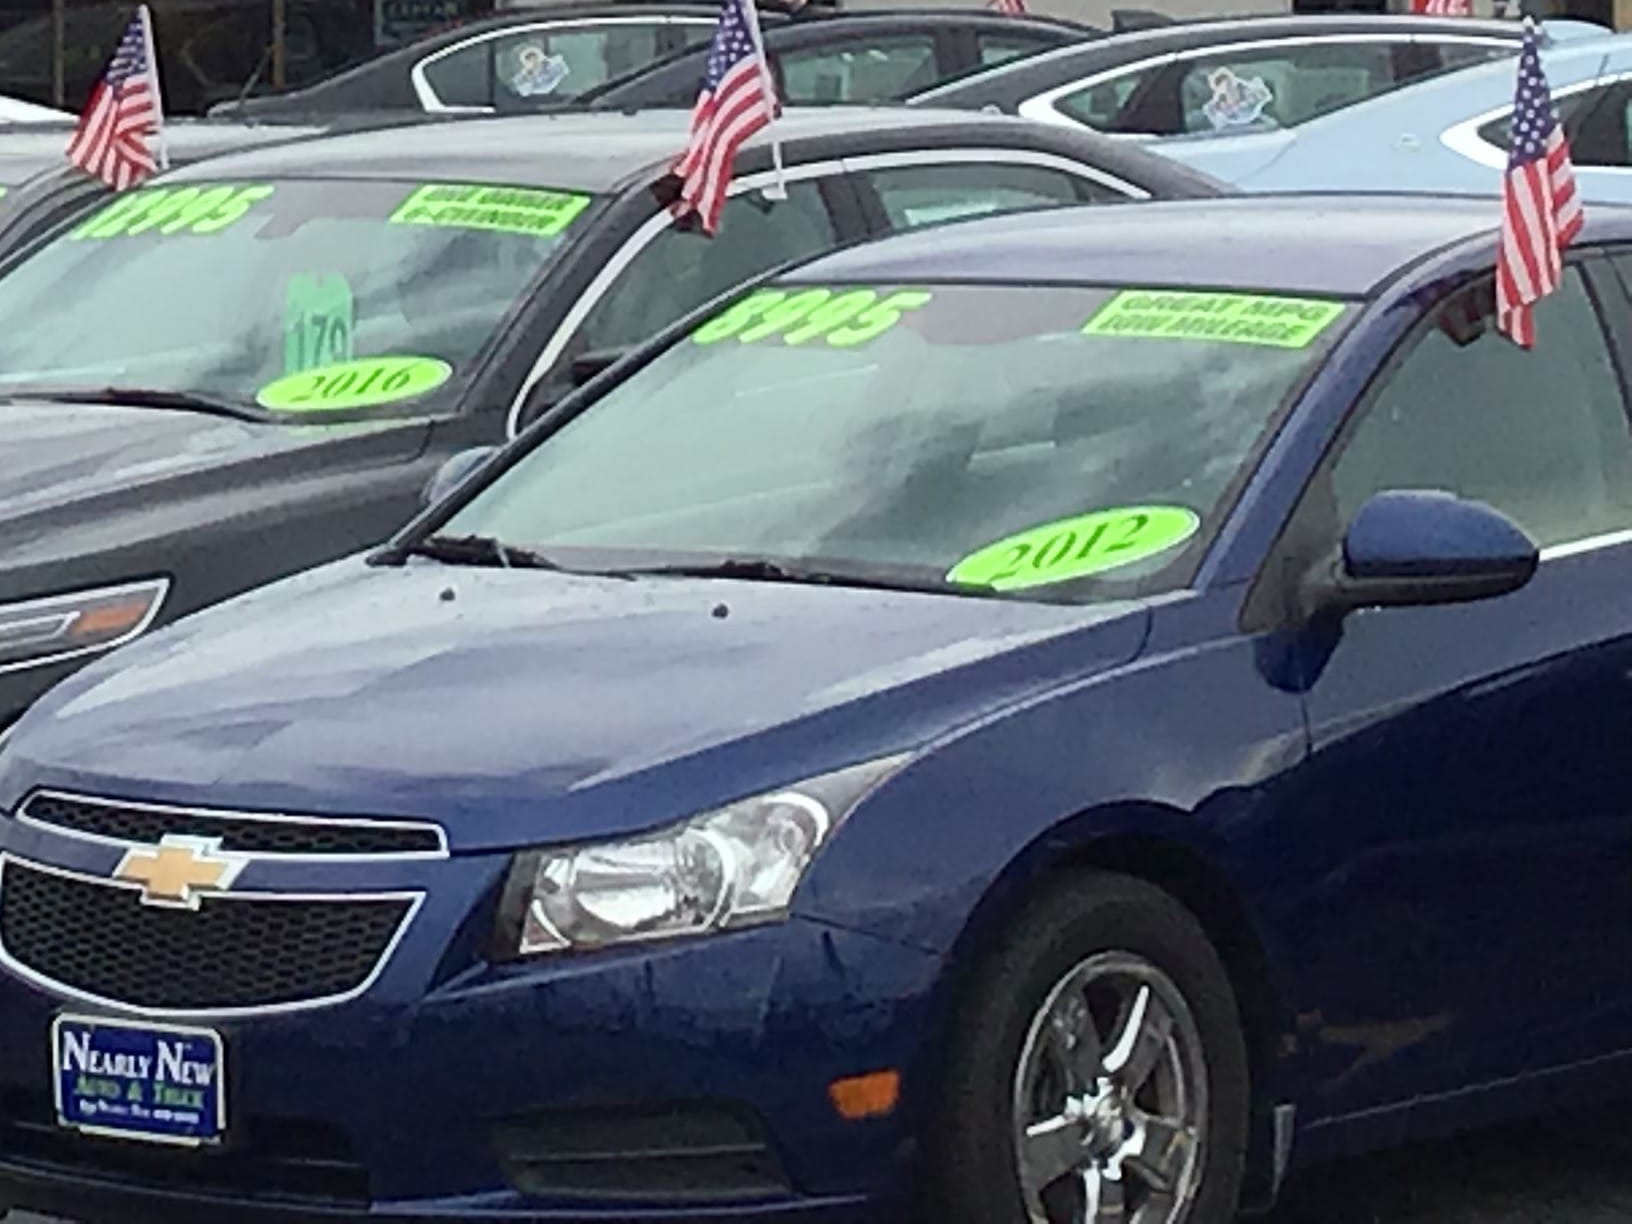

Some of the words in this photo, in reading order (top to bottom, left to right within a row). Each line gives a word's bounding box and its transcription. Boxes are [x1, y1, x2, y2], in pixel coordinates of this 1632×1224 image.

[692, 287, 934, 347] 8995
[287, 364, 418, 404] 2016
[987, 512, 1150, 584] 2012
[62, 1030, 153, 1079] NEARLY
[155, 1039, 216, 1086] NEW
